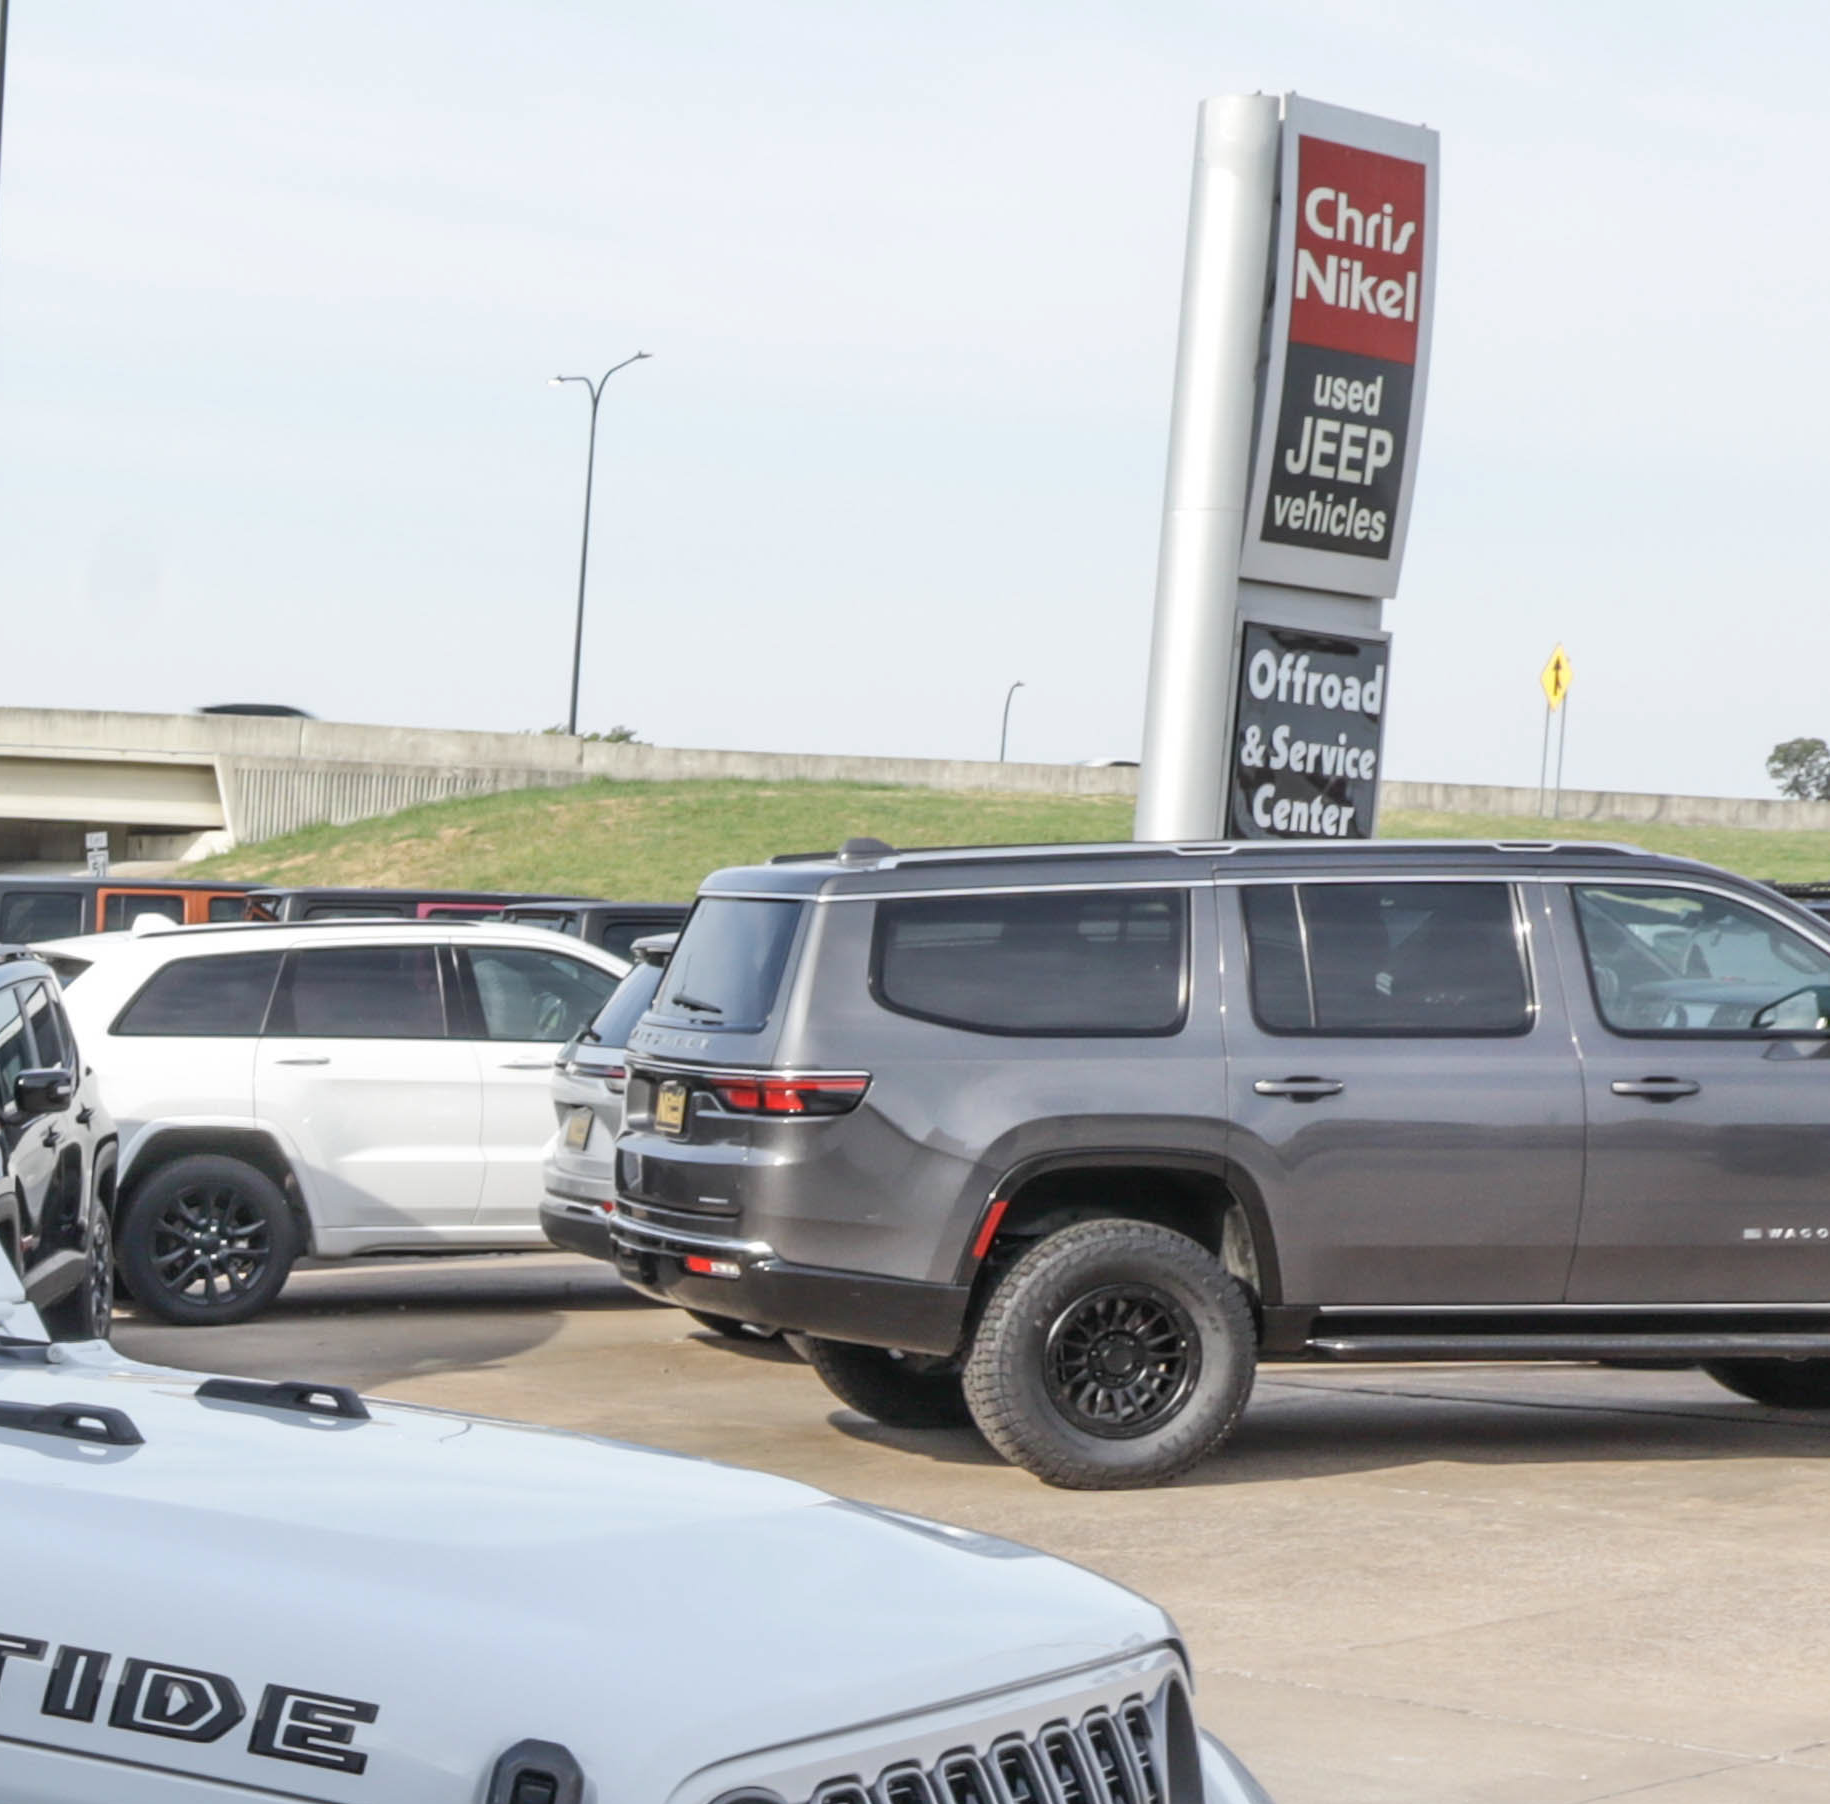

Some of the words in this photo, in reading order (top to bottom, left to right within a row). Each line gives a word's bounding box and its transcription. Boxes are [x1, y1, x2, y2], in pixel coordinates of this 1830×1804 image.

[1304, 186, 1416, 255] Chris
[1295, 248, 1418, 323] Nikel
[1313, 373, 1384, 417] used
[1284, 415, 1394, 486] JEEP
[1273, 489, 1387, 543] vehicles
[1247, 648, 1385, 715] Offroad
[1240, 724, 1266, 768] &
[1268, 724, 1377, 781] Service
[1252, 782, 1356, 837] Center
